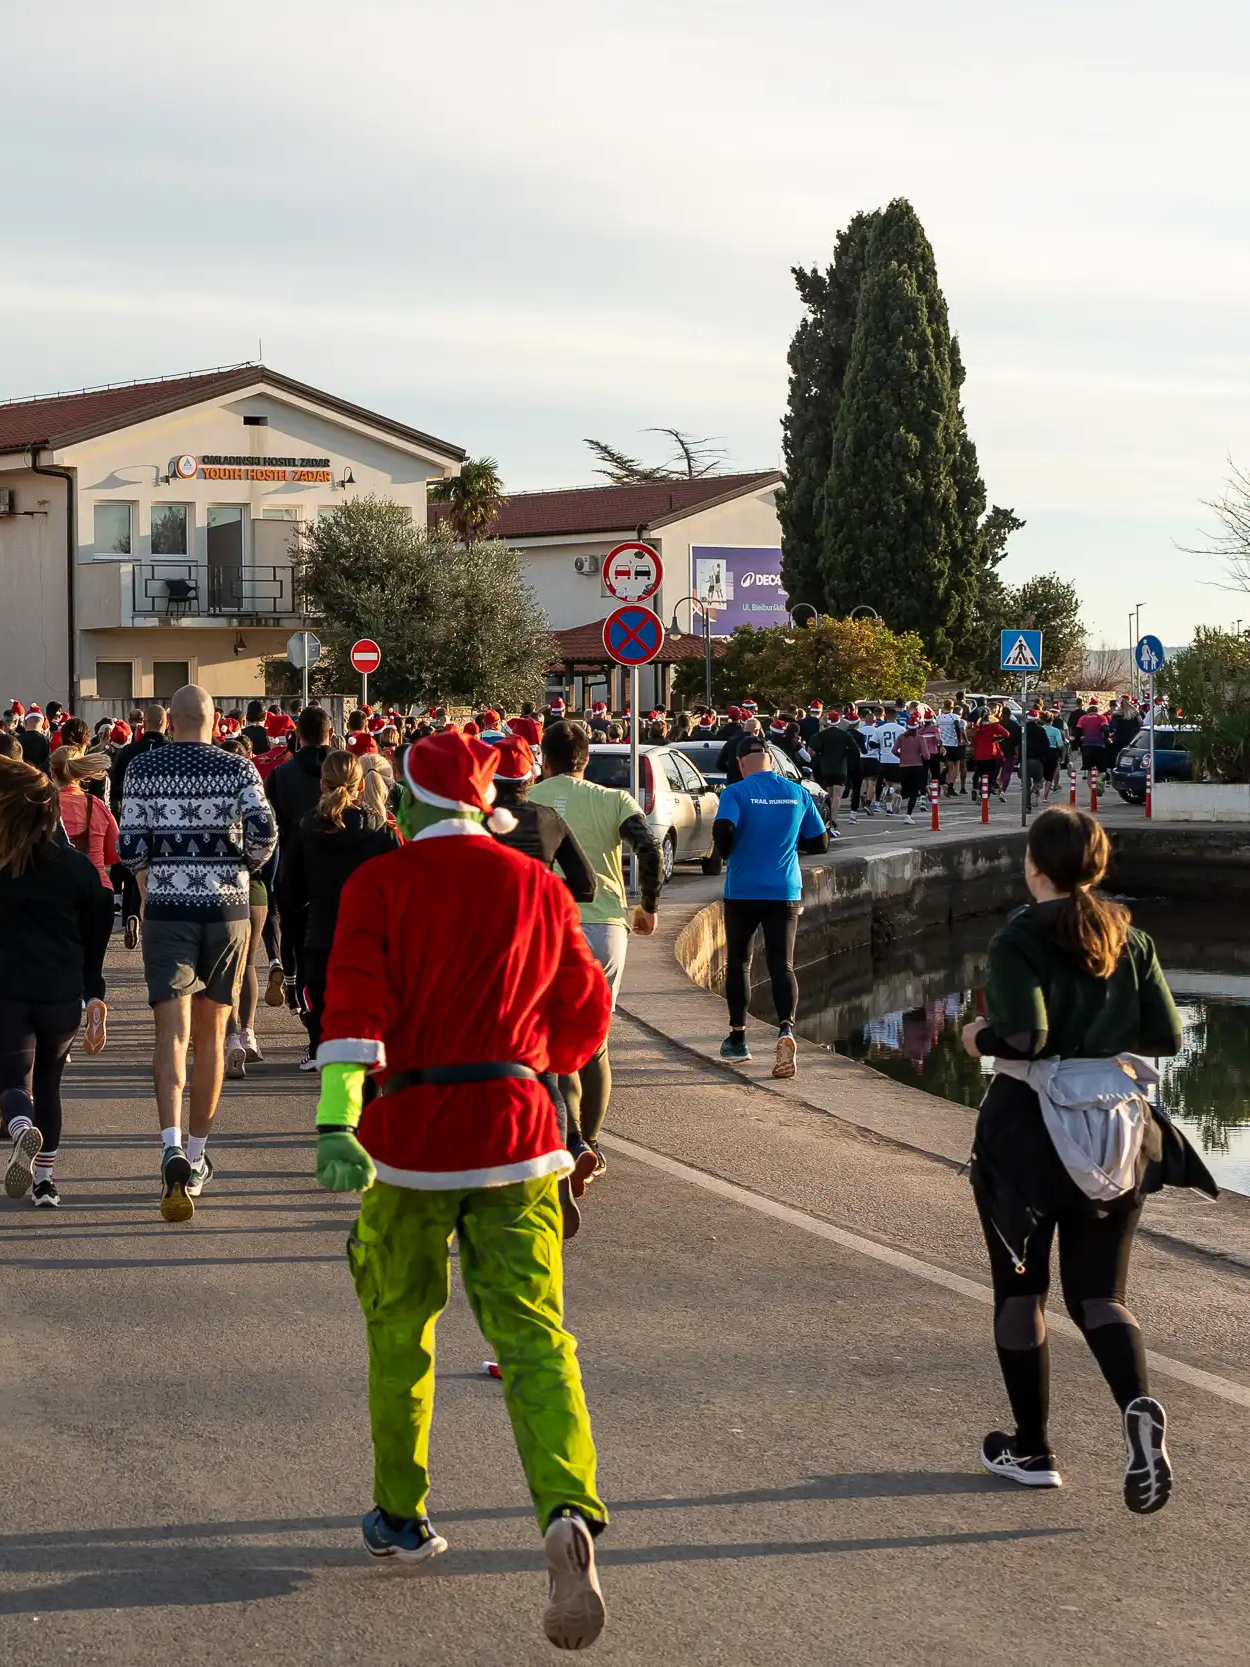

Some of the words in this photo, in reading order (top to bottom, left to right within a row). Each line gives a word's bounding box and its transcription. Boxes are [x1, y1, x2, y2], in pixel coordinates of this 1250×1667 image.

[202, 455, 261, 467] OMLADINSKI
[263, 457, 297, 467] HOSTEL
[299, 458, 330, 468] ZADAR
[203, 467, 243, 480] YOUTH
[246, 469, 289, 481] HOSTEL
[293, 470, 330, 482] ZADAR
[755, 574, 781, 586] DECA
[883, 731, 896, 748] 21
